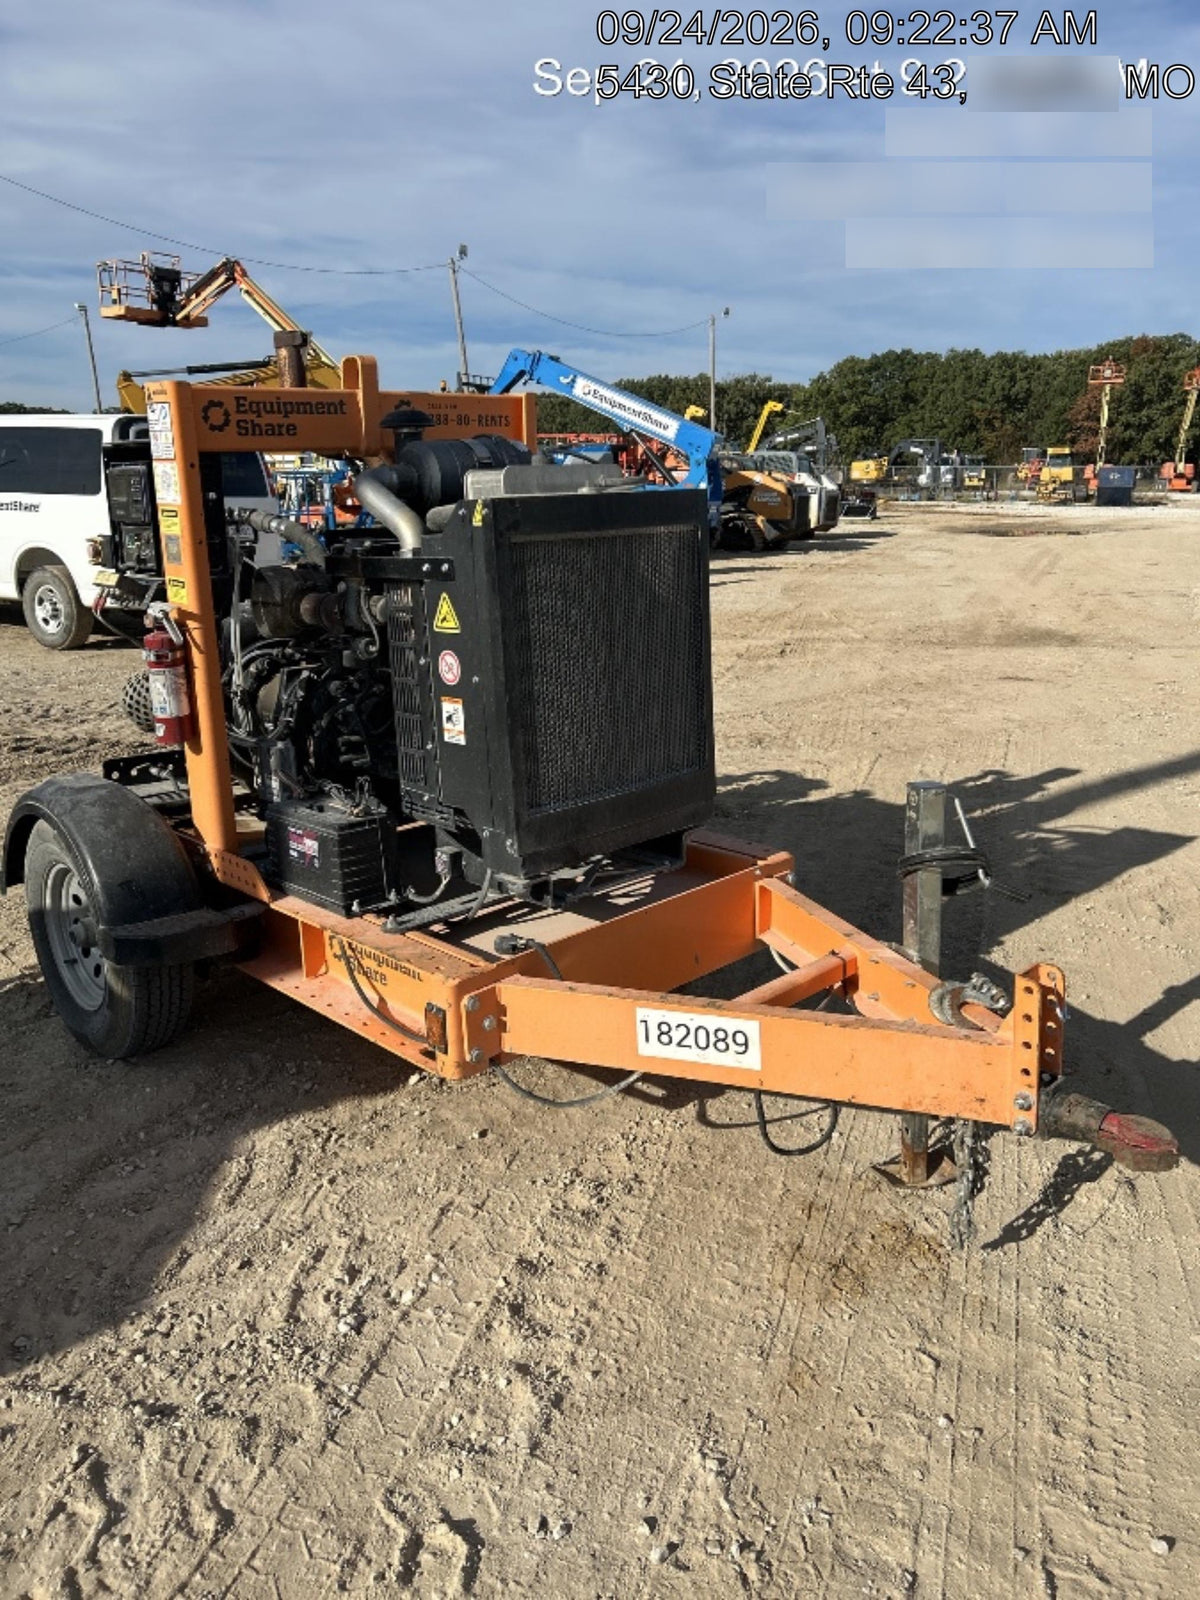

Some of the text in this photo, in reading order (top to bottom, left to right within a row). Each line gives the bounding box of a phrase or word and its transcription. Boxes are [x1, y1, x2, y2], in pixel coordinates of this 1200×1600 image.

[234, 396, 347, 418] Equipment
[236, 419, 298, 437] Share
[639, 1019, 750, 1056] 182089
